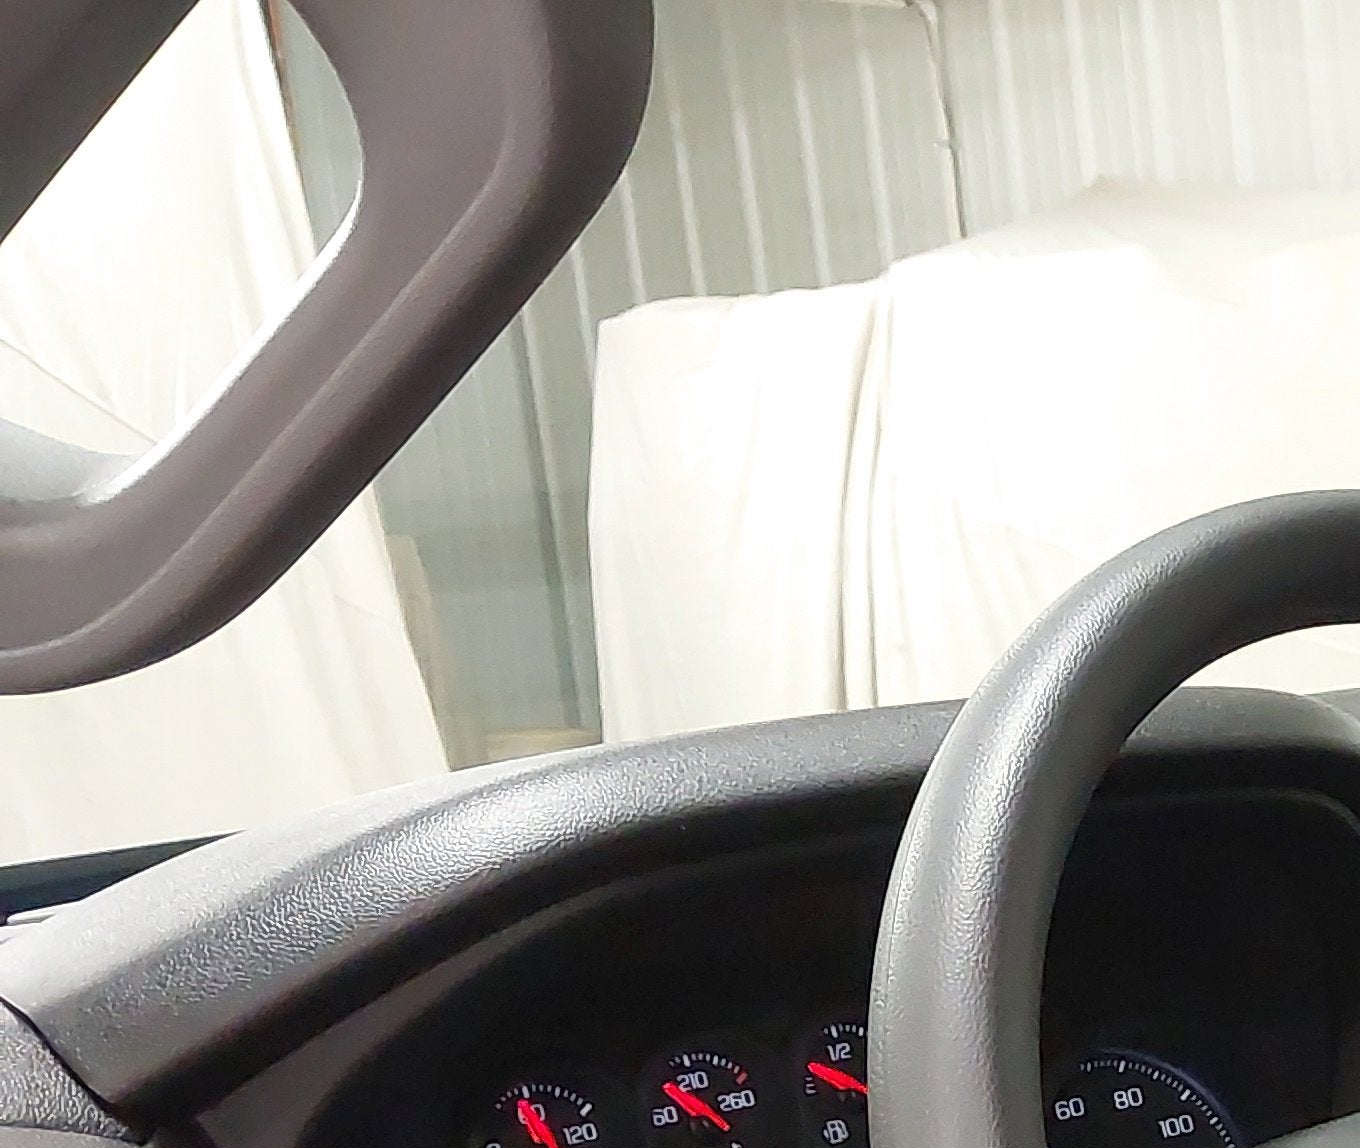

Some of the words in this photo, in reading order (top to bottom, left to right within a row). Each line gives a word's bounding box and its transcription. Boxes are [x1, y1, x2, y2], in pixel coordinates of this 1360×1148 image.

[676, 1071, 709, 1093] 210
[717, 1089, 756, 1112] 260
[1055, 1097, 1085, 1121] 60
[1114, 1087, 1143, 1110] 80
[562, 1122, 599, 1145] 120
[1158, 1114, 1194, 1139] 100
